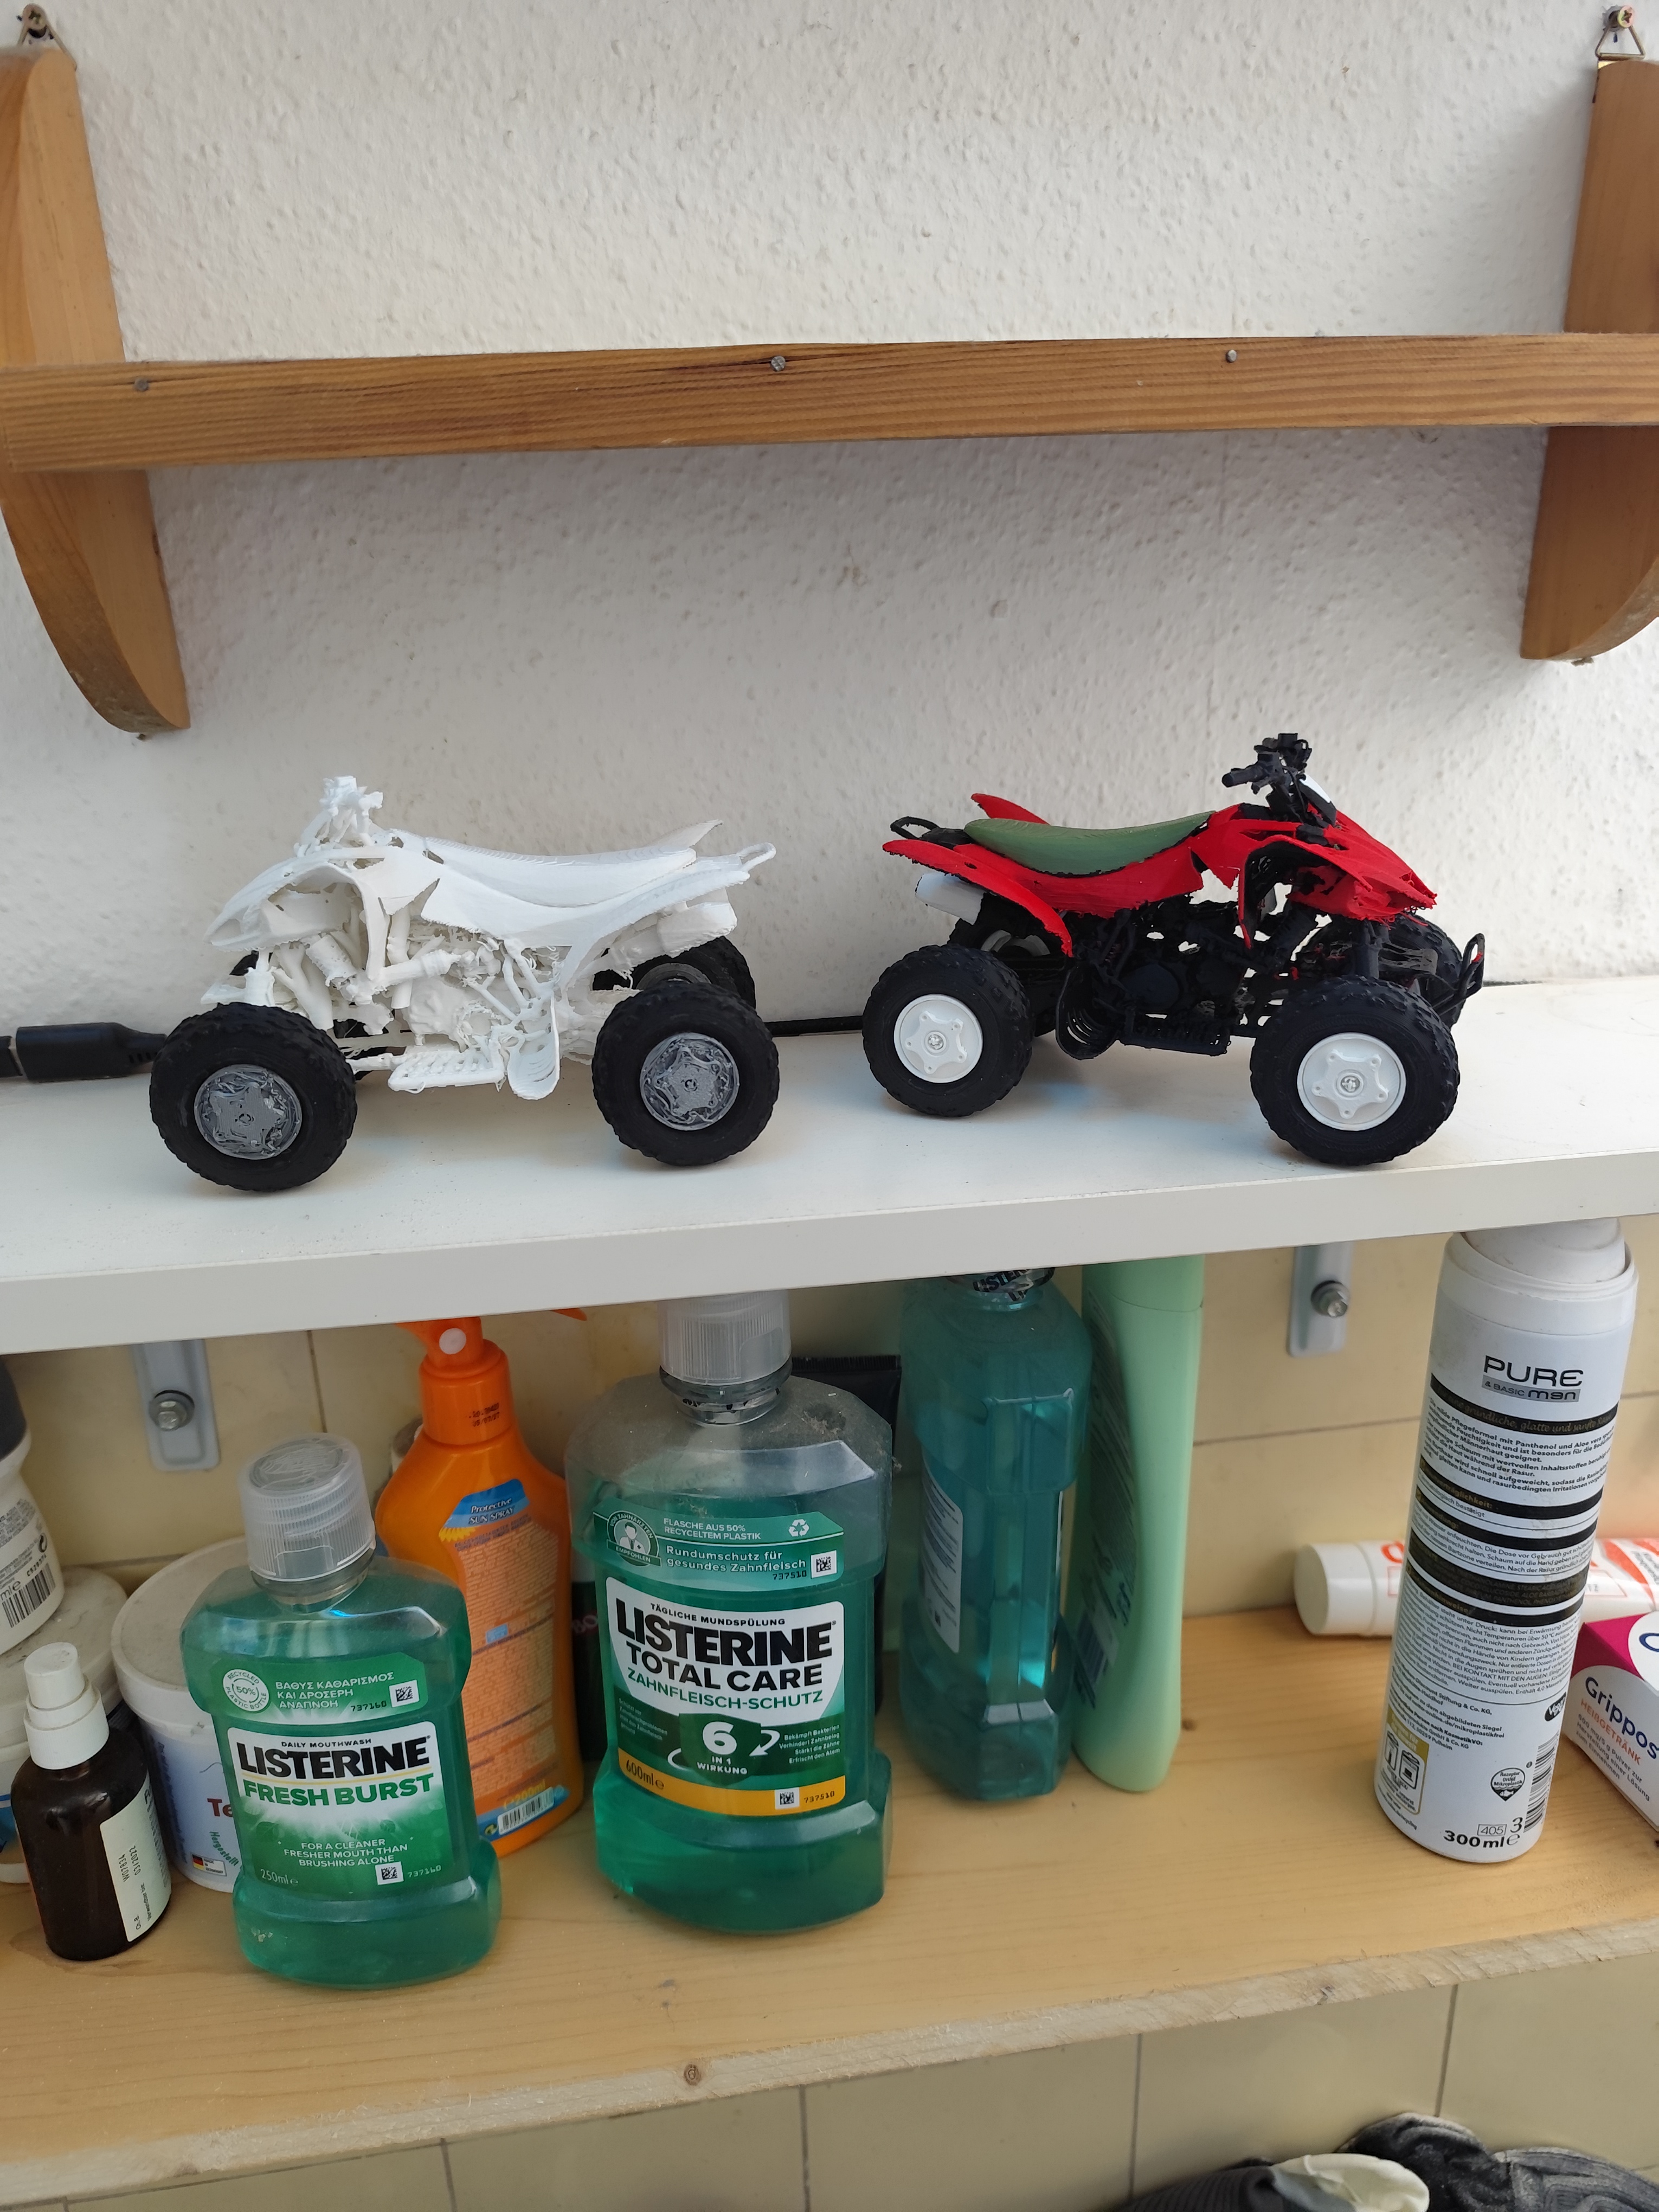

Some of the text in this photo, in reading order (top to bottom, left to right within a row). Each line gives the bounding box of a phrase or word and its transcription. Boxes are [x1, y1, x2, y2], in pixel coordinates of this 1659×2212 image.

[1483, 1355, 1584, 1387] PURE
[1493, 1382, 1525, 1396] BASIC
[1451, 1417, 1497, 1440] Pflegeformel
[1515, 1441, 1557, 1449] Panthenol
[1552, 1423, 1571, 1433] und
[1457, 1427, 1501, 1448] Feuchtigkeit
[1455, 1442, 1481, 1457] Schaum
[1496, 1458, 1539, 1470] wertvollen
[1541, 1462, 1587, 1471] Inhaltsstoffen
[1460, 1436, 1542, 1463] Männerhaut geeignet.
[1448, 1445, 1535, 1477] Haut während der Rasur.
[1454, 1457, 1469, 1468] wird
[1471, 1466, 1497, 1478] schnell
[1499, 1474, 1549, 1486] aufgeweicht,
[1459, 1467, 1587, 1493] kann und rasurbedingten Irritationen
[471, 1498, 512, 1514] Protective
[468, 1507, 515, 1525] SUN SPRAY
[664, 1518, 704, 1531] FLASCHE
[664, 1526, 761, 1541] RECYCELTEM PLASTIK
[616, 1546, 651, 1562] EMPFOHLEN
[666, 1545, 782, 1561] Rundumschutz für
[1446, 1531, 1483, 1550] anfeuchten.
[1485, 1546, 1496, 1554] Die
[1499, 1549, 1516, 1557] Dose
[1531, 1551, 1561, 1560] Gebrauch
[667, 1558, 806, 1573] gesundes Zahnfleisch
[1448, 1545, 1475, 1561] Bartzone
[1476, 1558, 1506, 1570] verteilen.
[1487, 1553, 1513, 1564] Schaum
[772, 1570, 807, 1581] 737510
[651, 1602, 786, 1626] TÄGLICHE MUNDSPÜLUNG
[616, 1598, 832, 1667] LISTERINE
[1484, 1631, 1526, 1641] Temperaturen
[626, 1641, 823, 1692] TOTAL CARE
[1464, 1667, 1496, 1680] KONTAKT
[227, 1671, 260, 1684] RECYCLED
[275, 1671, 395, 1690] ΒΑΘΥΣ ΚΑΘΑΡΙΣΜΟΣ
[236, 1686, 256, 1696] 50%
[277, 1688, 353, 1699] ΚΑΙ ΔΡΟΣΕΡΗ
[627, 1667, 824, 1709] ZAHNFLEISCH-SCHUTZ
[226, 1686, 267, 1709] PLASTIC BOTTLE
[279, 1700, 338, 1709] ΑΝΑΠΝΟΗ
[350, 1700, 387, 1712] 737160
[1439, 1711, 1481, 1728] abgebildeten
[1585, 1676, 1659, 1760] Grippos
[702, 1721, 737, 1755] 6
[779, 1732, 840, 1750] Verhindert Zahnbelag
[784, 1725, 840, 1741] Bekämpft Bakterien
[310, 1738, 372, 1748] MOUTHWASH
[823, 1740, 840, 1749] Zähne
[236, 1736, 430, 1779] LISTERINE
[712, 1756, 723, 1764] IN
[789, 1754, 813, 1764] Erfrischt
[825, 1748, 840, 1757] Atem
[1577, 1721, 1650, 1802] Herstellung einer Lösung
[1588, 1742, 1621, 1780] Einnehmen
[626, 1759, 654, 1786] 600ml
[697, 1761, 748, 1774] WIRKUNG
[1611, 1748, 1631, 1772] Pulver
[1631, 1771, 1643, 1784] zur
[243, 1773, 434, 1806] FRESH BURST
[804, 1790, 835, 1804] 737510
[1480, 1826, 1504, 1835] 405
[1510, 1817, 1523, 1834] 3
[284, 1843, 408, 1859] FRESHER MOUTH THAN
[301, 1838, 385, 1850] FOR A CLEANER
[118, 1854, 130, 1882] W07834
[357, 1855, 395, 1866] ALONE
[260, 1868, 289, 1885] 250ml
[407, 1864, 442, 1879] 737160
